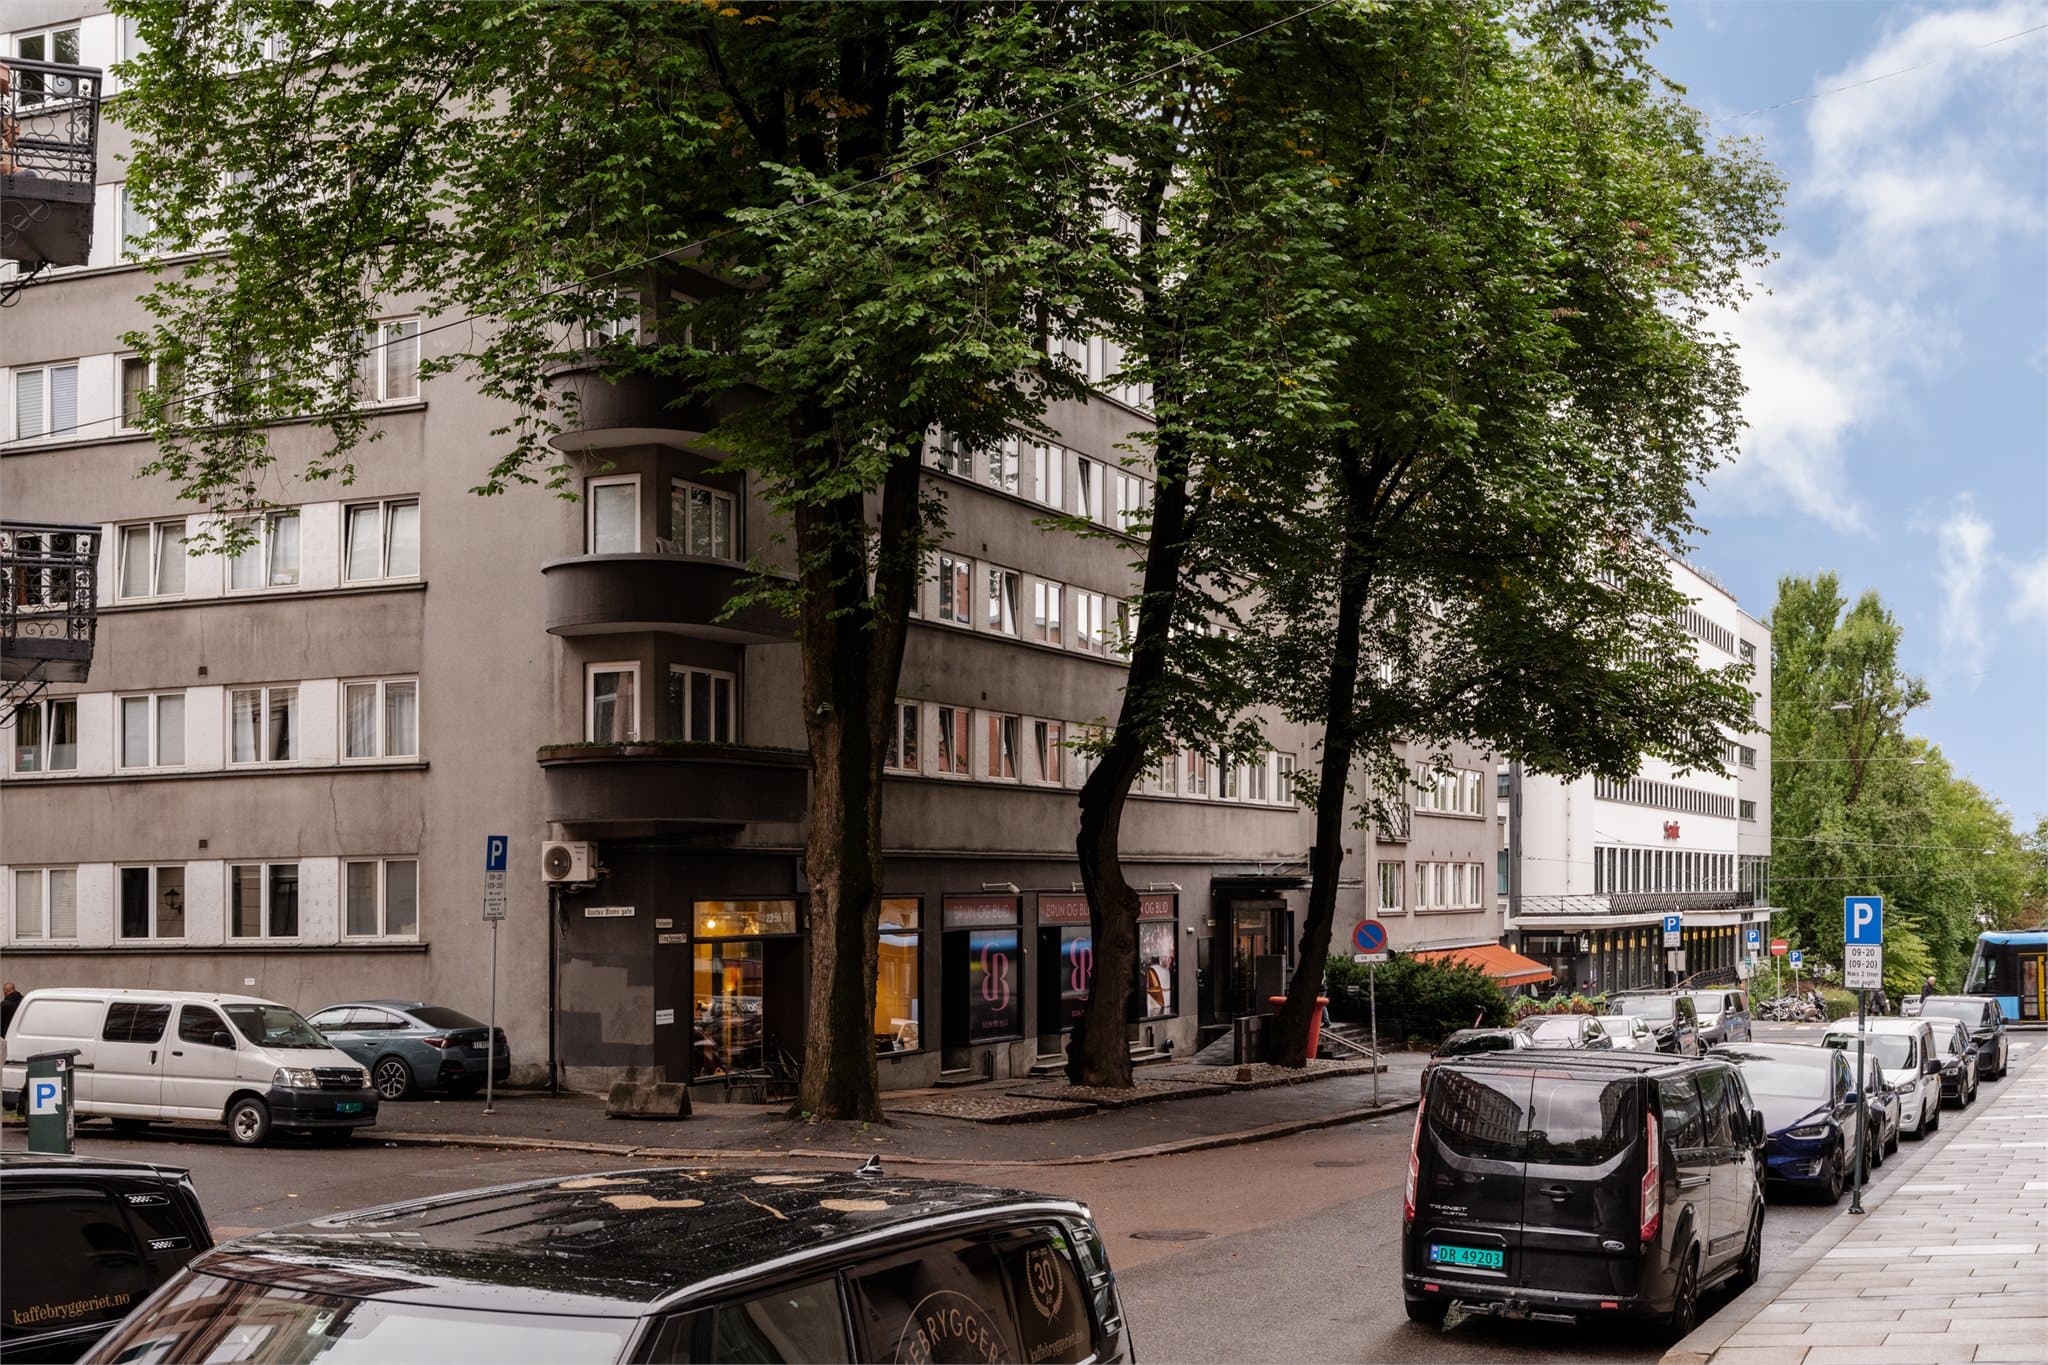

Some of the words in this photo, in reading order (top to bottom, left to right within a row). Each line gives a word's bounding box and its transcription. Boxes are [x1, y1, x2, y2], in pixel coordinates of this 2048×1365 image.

[490, 840, 503, 867] P
[953, 905, 976, 920] BRUN
[977, 904, 991, 919] OG
[1046, 904, 1065, 918] BRUN
[1066, 904, 1079, 917] OG
[1144, 902, 1154, 914] OG
[1667, 918, 1676, 931] P
[1853, 903, 1873, 939] P
[1749, 932, 1757, 942] P
[1792, 952, 1799, 960] P
[1851, 948, 1875, 957] 09-20
[1848, 960, 1878, 969] (09-20)
[37, 1084, 56, 1109] P
[1429, 1203, 1468, 1212] TRANSIT
[1440, 1247, 1456, 1261] DR
[1462, 1250, 1501, 1265] 49203
[1034, 1260, 1054, 1294] 30
[12, 1293, 130, 1325] kaffebryggeriet.no
